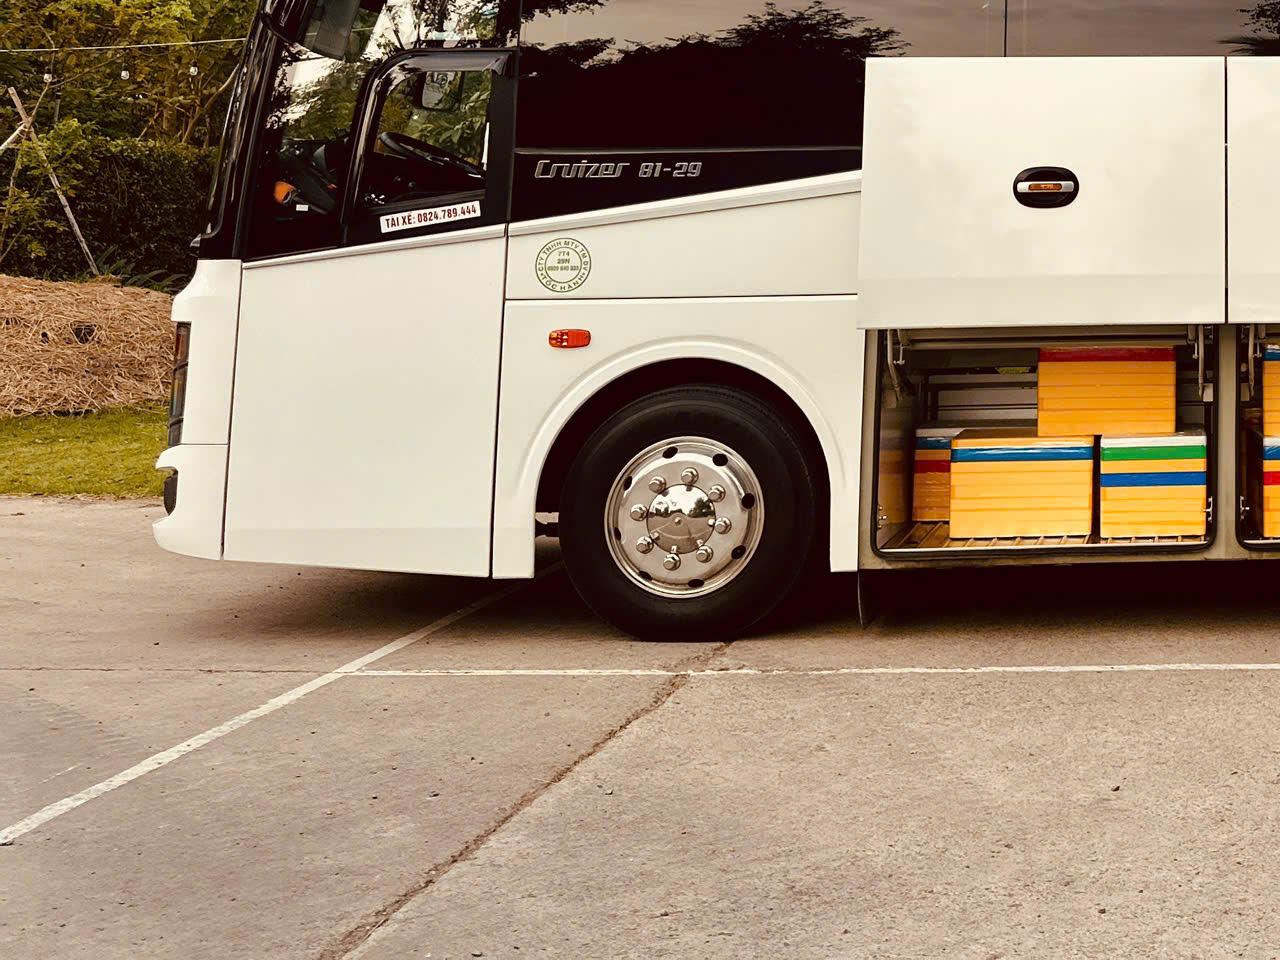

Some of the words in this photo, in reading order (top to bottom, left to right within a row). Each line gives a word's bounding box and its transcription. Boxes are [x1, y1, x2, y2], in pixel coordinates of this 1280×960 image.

[534, 159, 630, 179] Cruizer
[638, 161, 702, 178] 81-29
[417, 204, 477, 223] 0824.789.444
[542, 241, 562, 256] TNHH
[563, 240, 580, 249] MTV
[579, 248, 588, 259] TM
